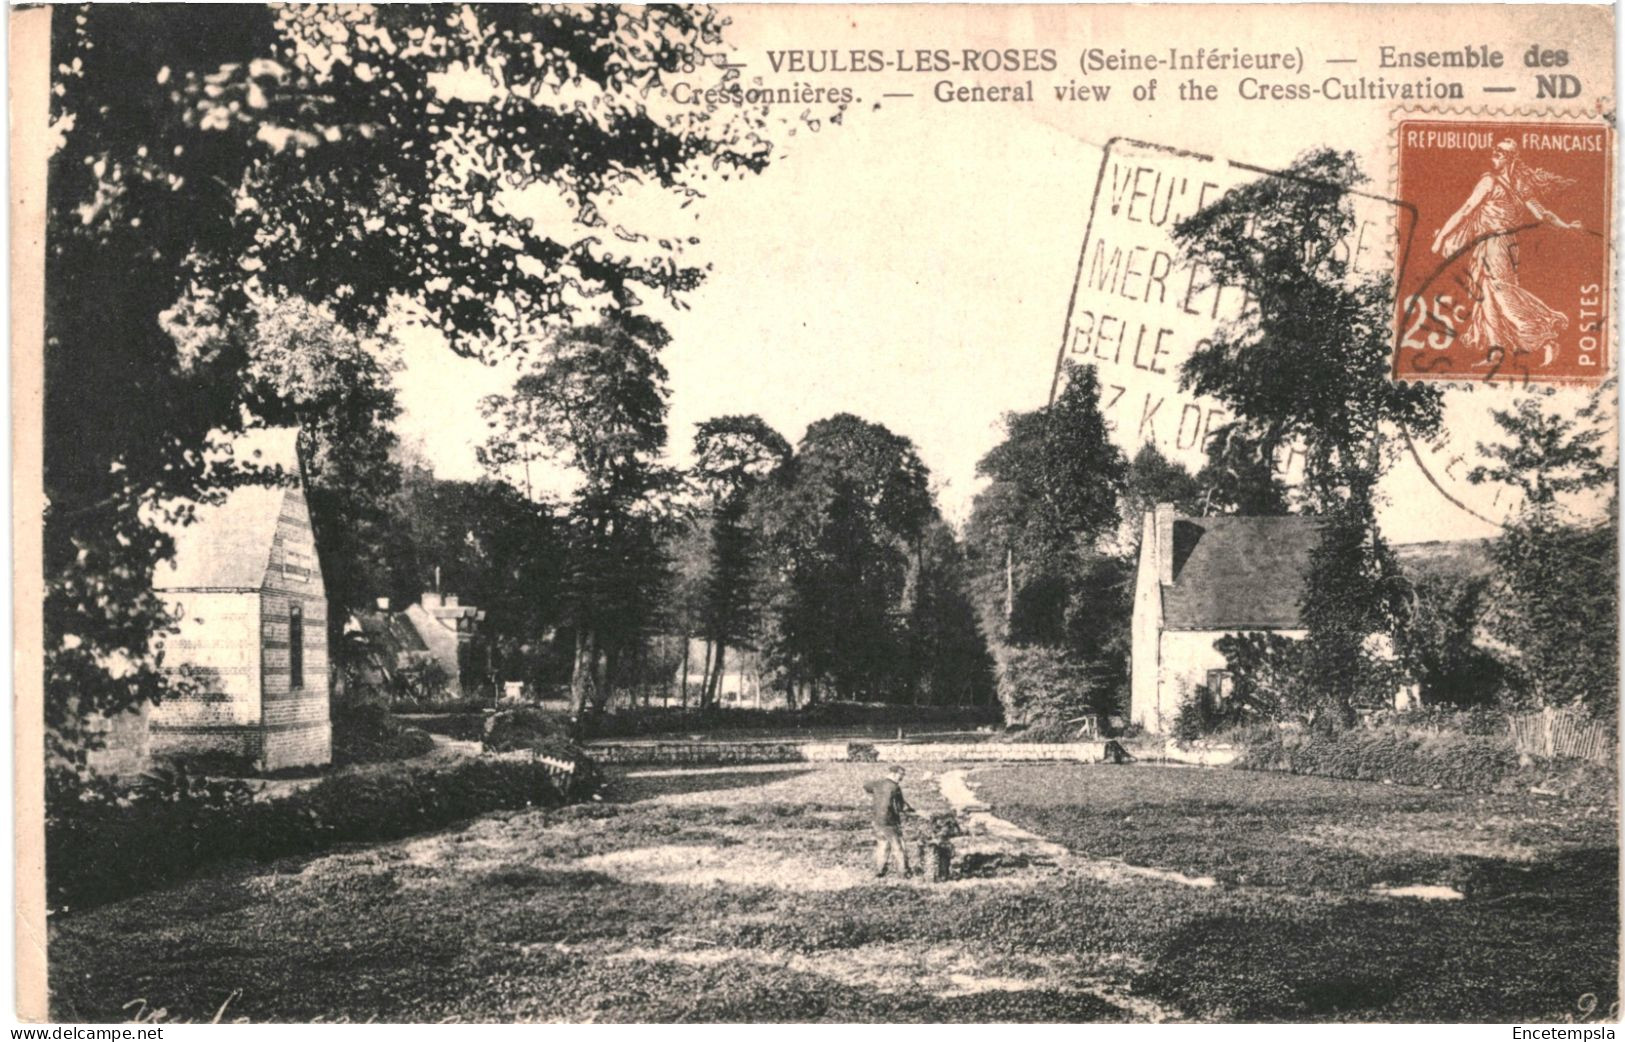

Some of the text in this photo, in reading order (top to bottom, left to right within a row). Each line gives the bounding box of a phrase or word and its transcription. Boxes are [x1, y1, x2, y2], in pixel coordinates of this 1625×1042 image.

[1522, 132, 1603, 154] FRANÇAISE
[1089, 238, 1173, 304] MER
[1578, 282, 1600, 367] POSTES
